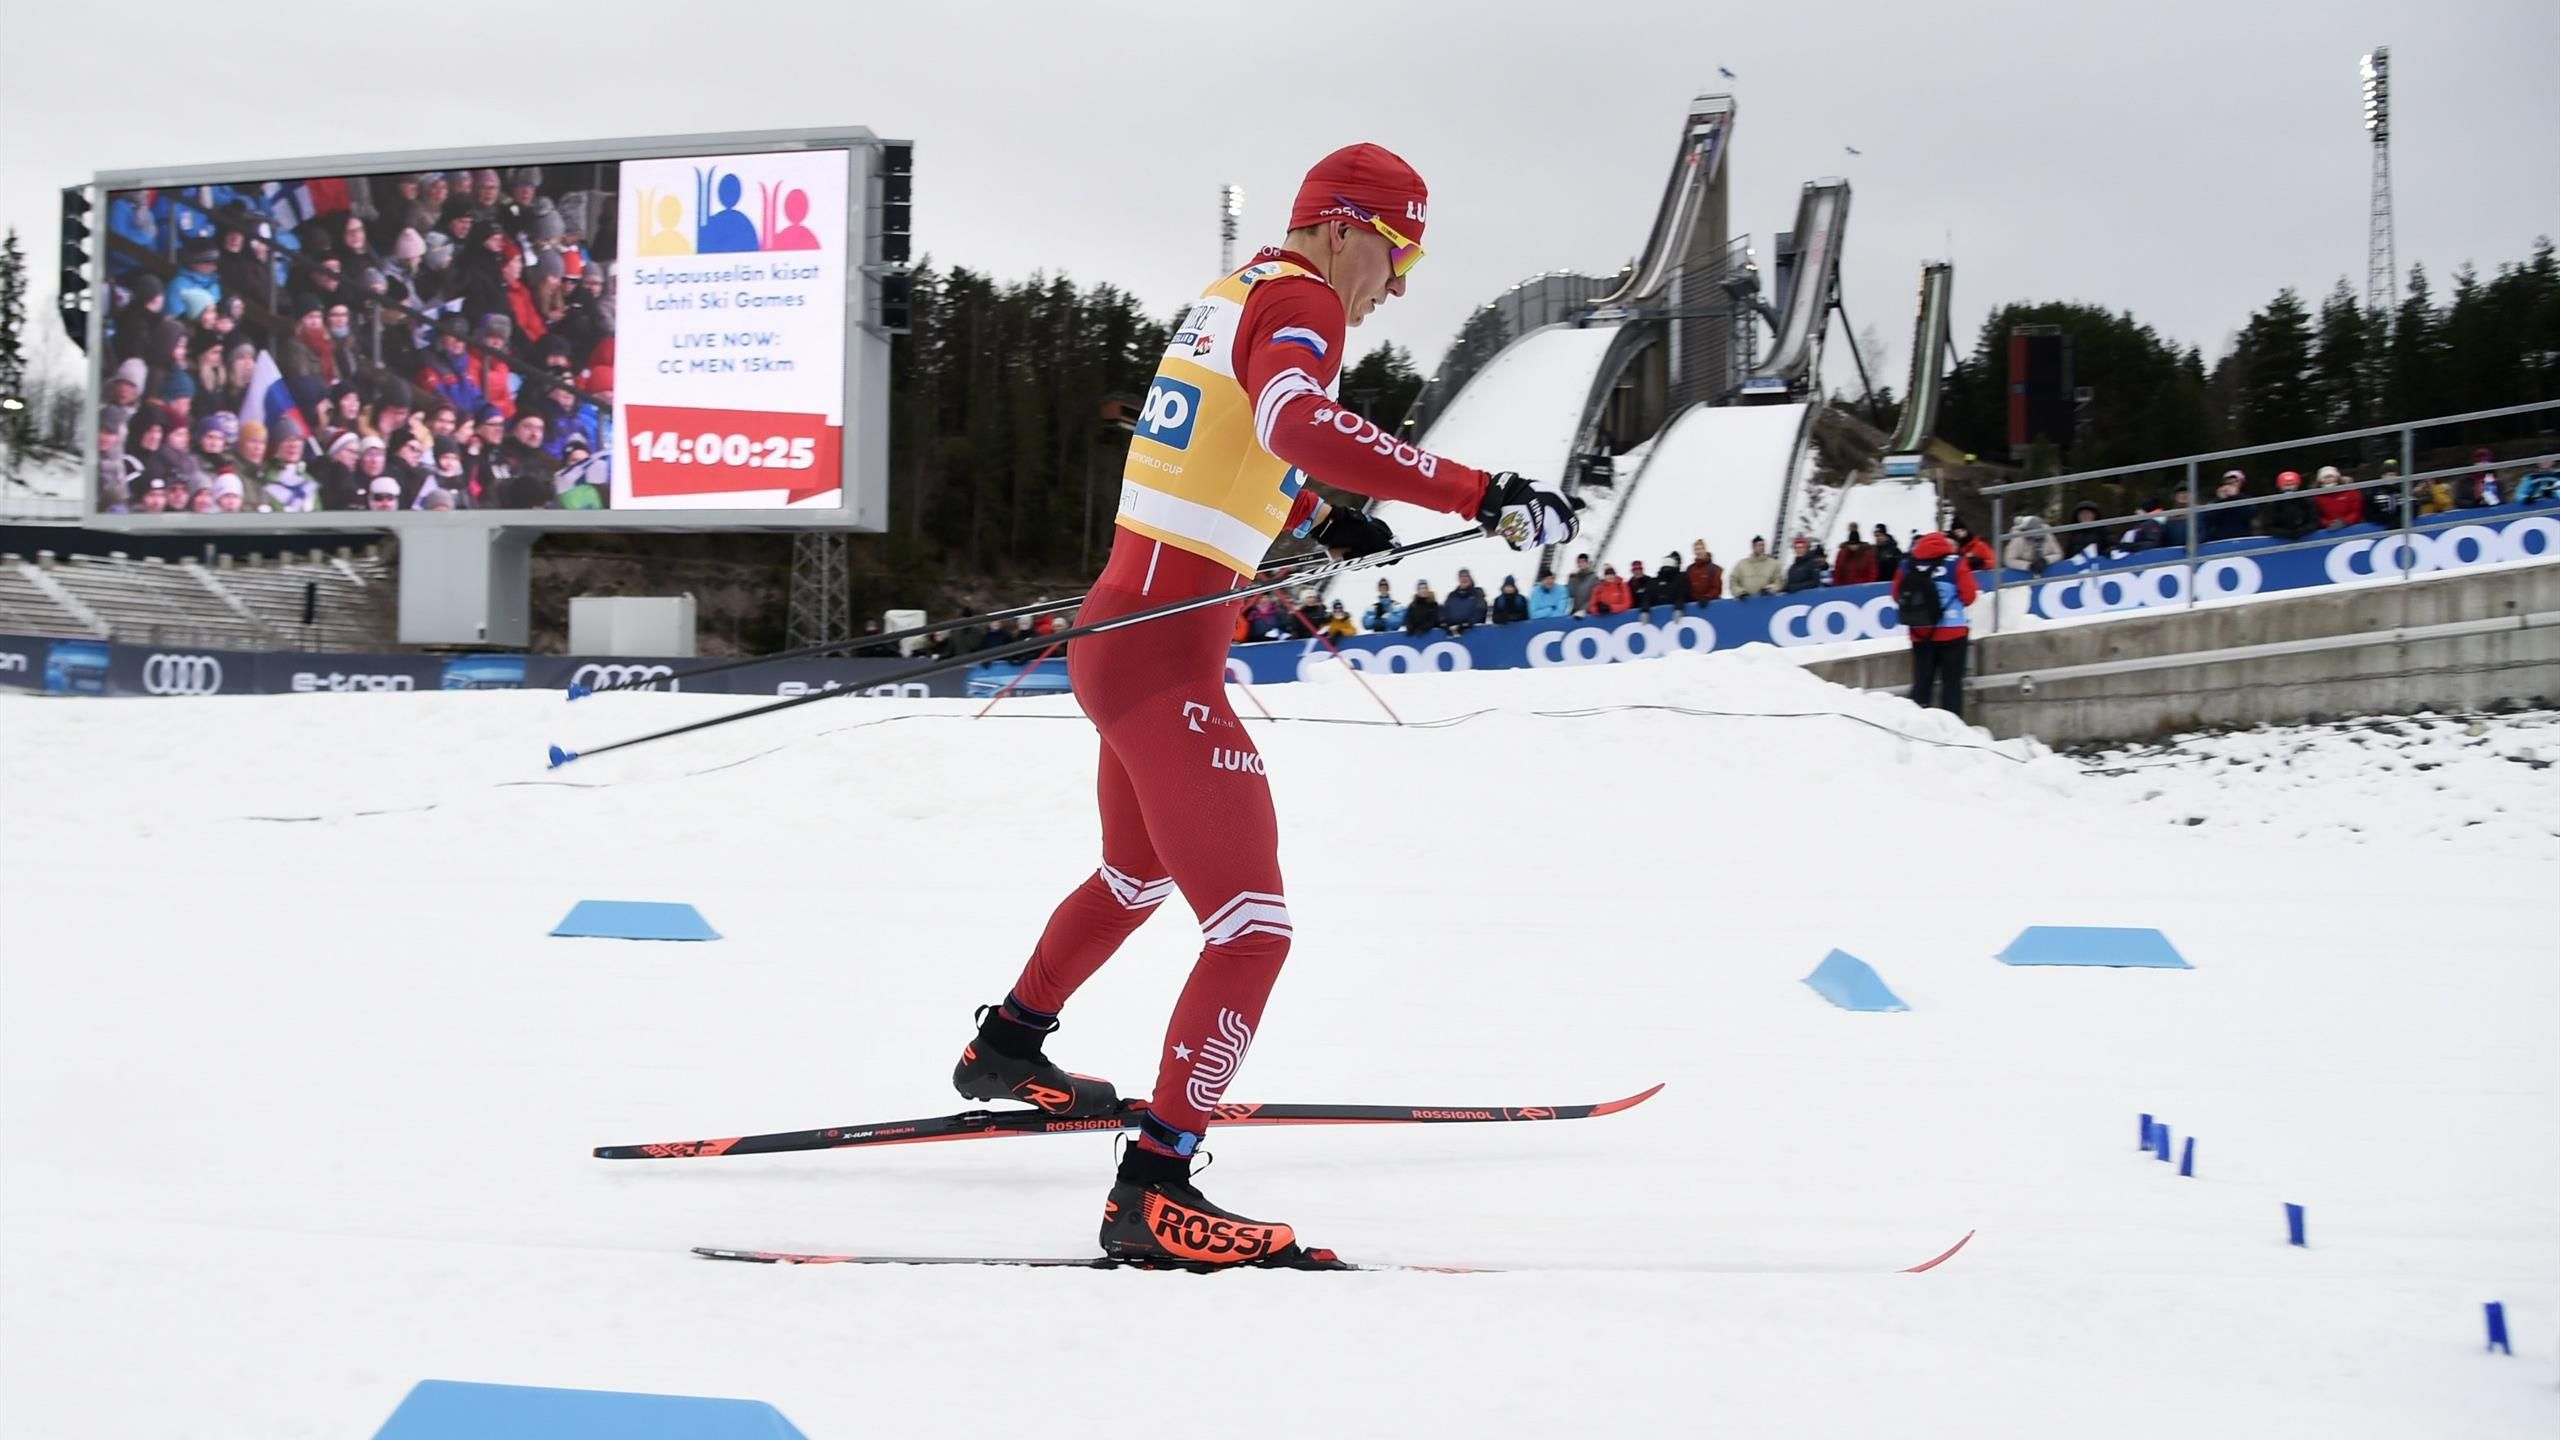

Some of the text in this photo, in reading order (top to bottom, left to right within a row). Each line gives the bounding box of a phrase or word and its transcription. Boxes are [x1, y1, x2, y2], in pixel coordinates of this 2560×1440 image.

[633, 262, 820, 288] Salpausselän kisat
[645, 291, 806, 311] Lahti Ski Games
[672, 331, 781, 348] LIVE NOW:
[657, 356, 795, 374] CC MEN 15km
[630, 430, 816, 469] 14:00:25
[1333, 409, 1438, 478] BOSCO
[1162, 461, 1184, 476] CUP
[291, 672, 414, 692] e-tron
[1411, 1110, 1496, 1120] ROSSIGNOL
[874, 1127, 916, 1137] PREMIUM
[1046, 1119, 1125, 1132] ROSSIGNOL
[1155, 1203, 1273, 1259] ROSSI
